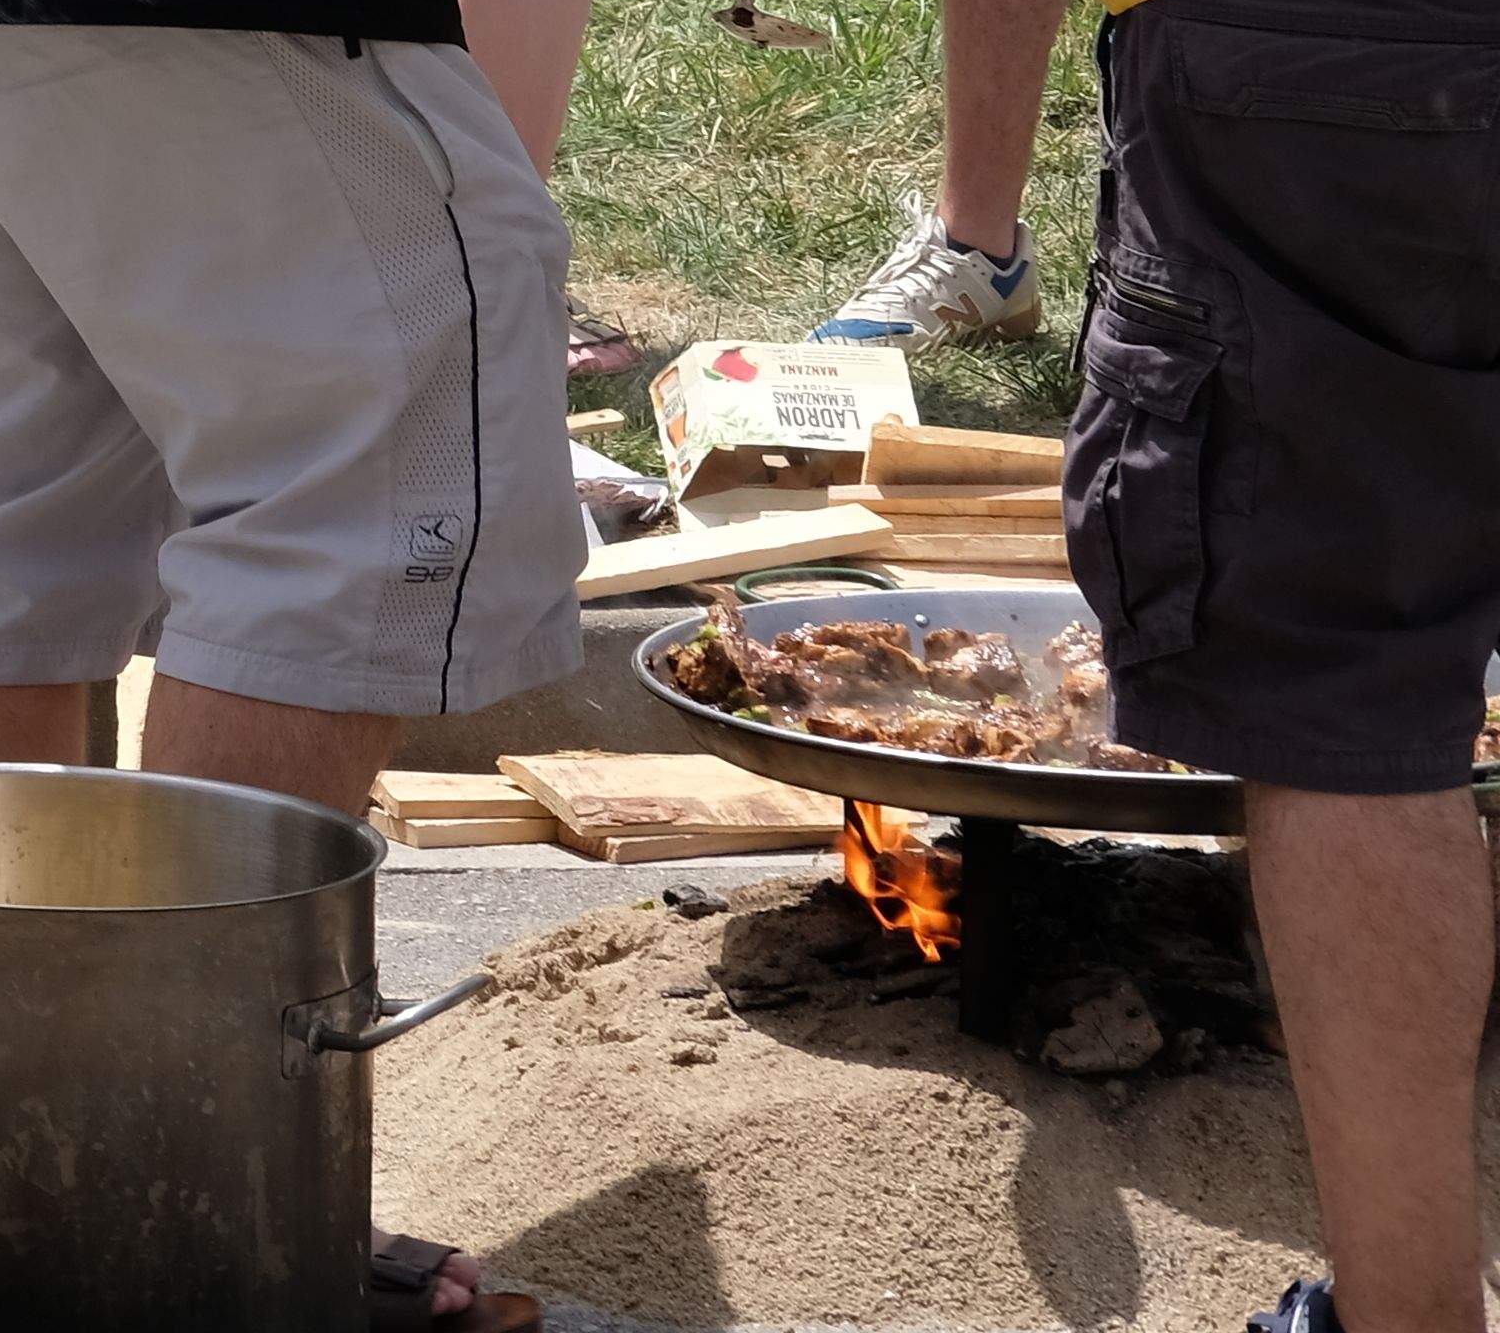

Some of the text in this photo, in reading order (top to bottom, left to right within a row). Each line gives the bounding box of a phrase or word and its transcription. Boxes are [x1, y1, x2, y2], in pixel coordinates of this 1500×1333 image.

[780, 364, 839, 377] MANZANA
[772, 391, 856, 407] DE MANZANAS
